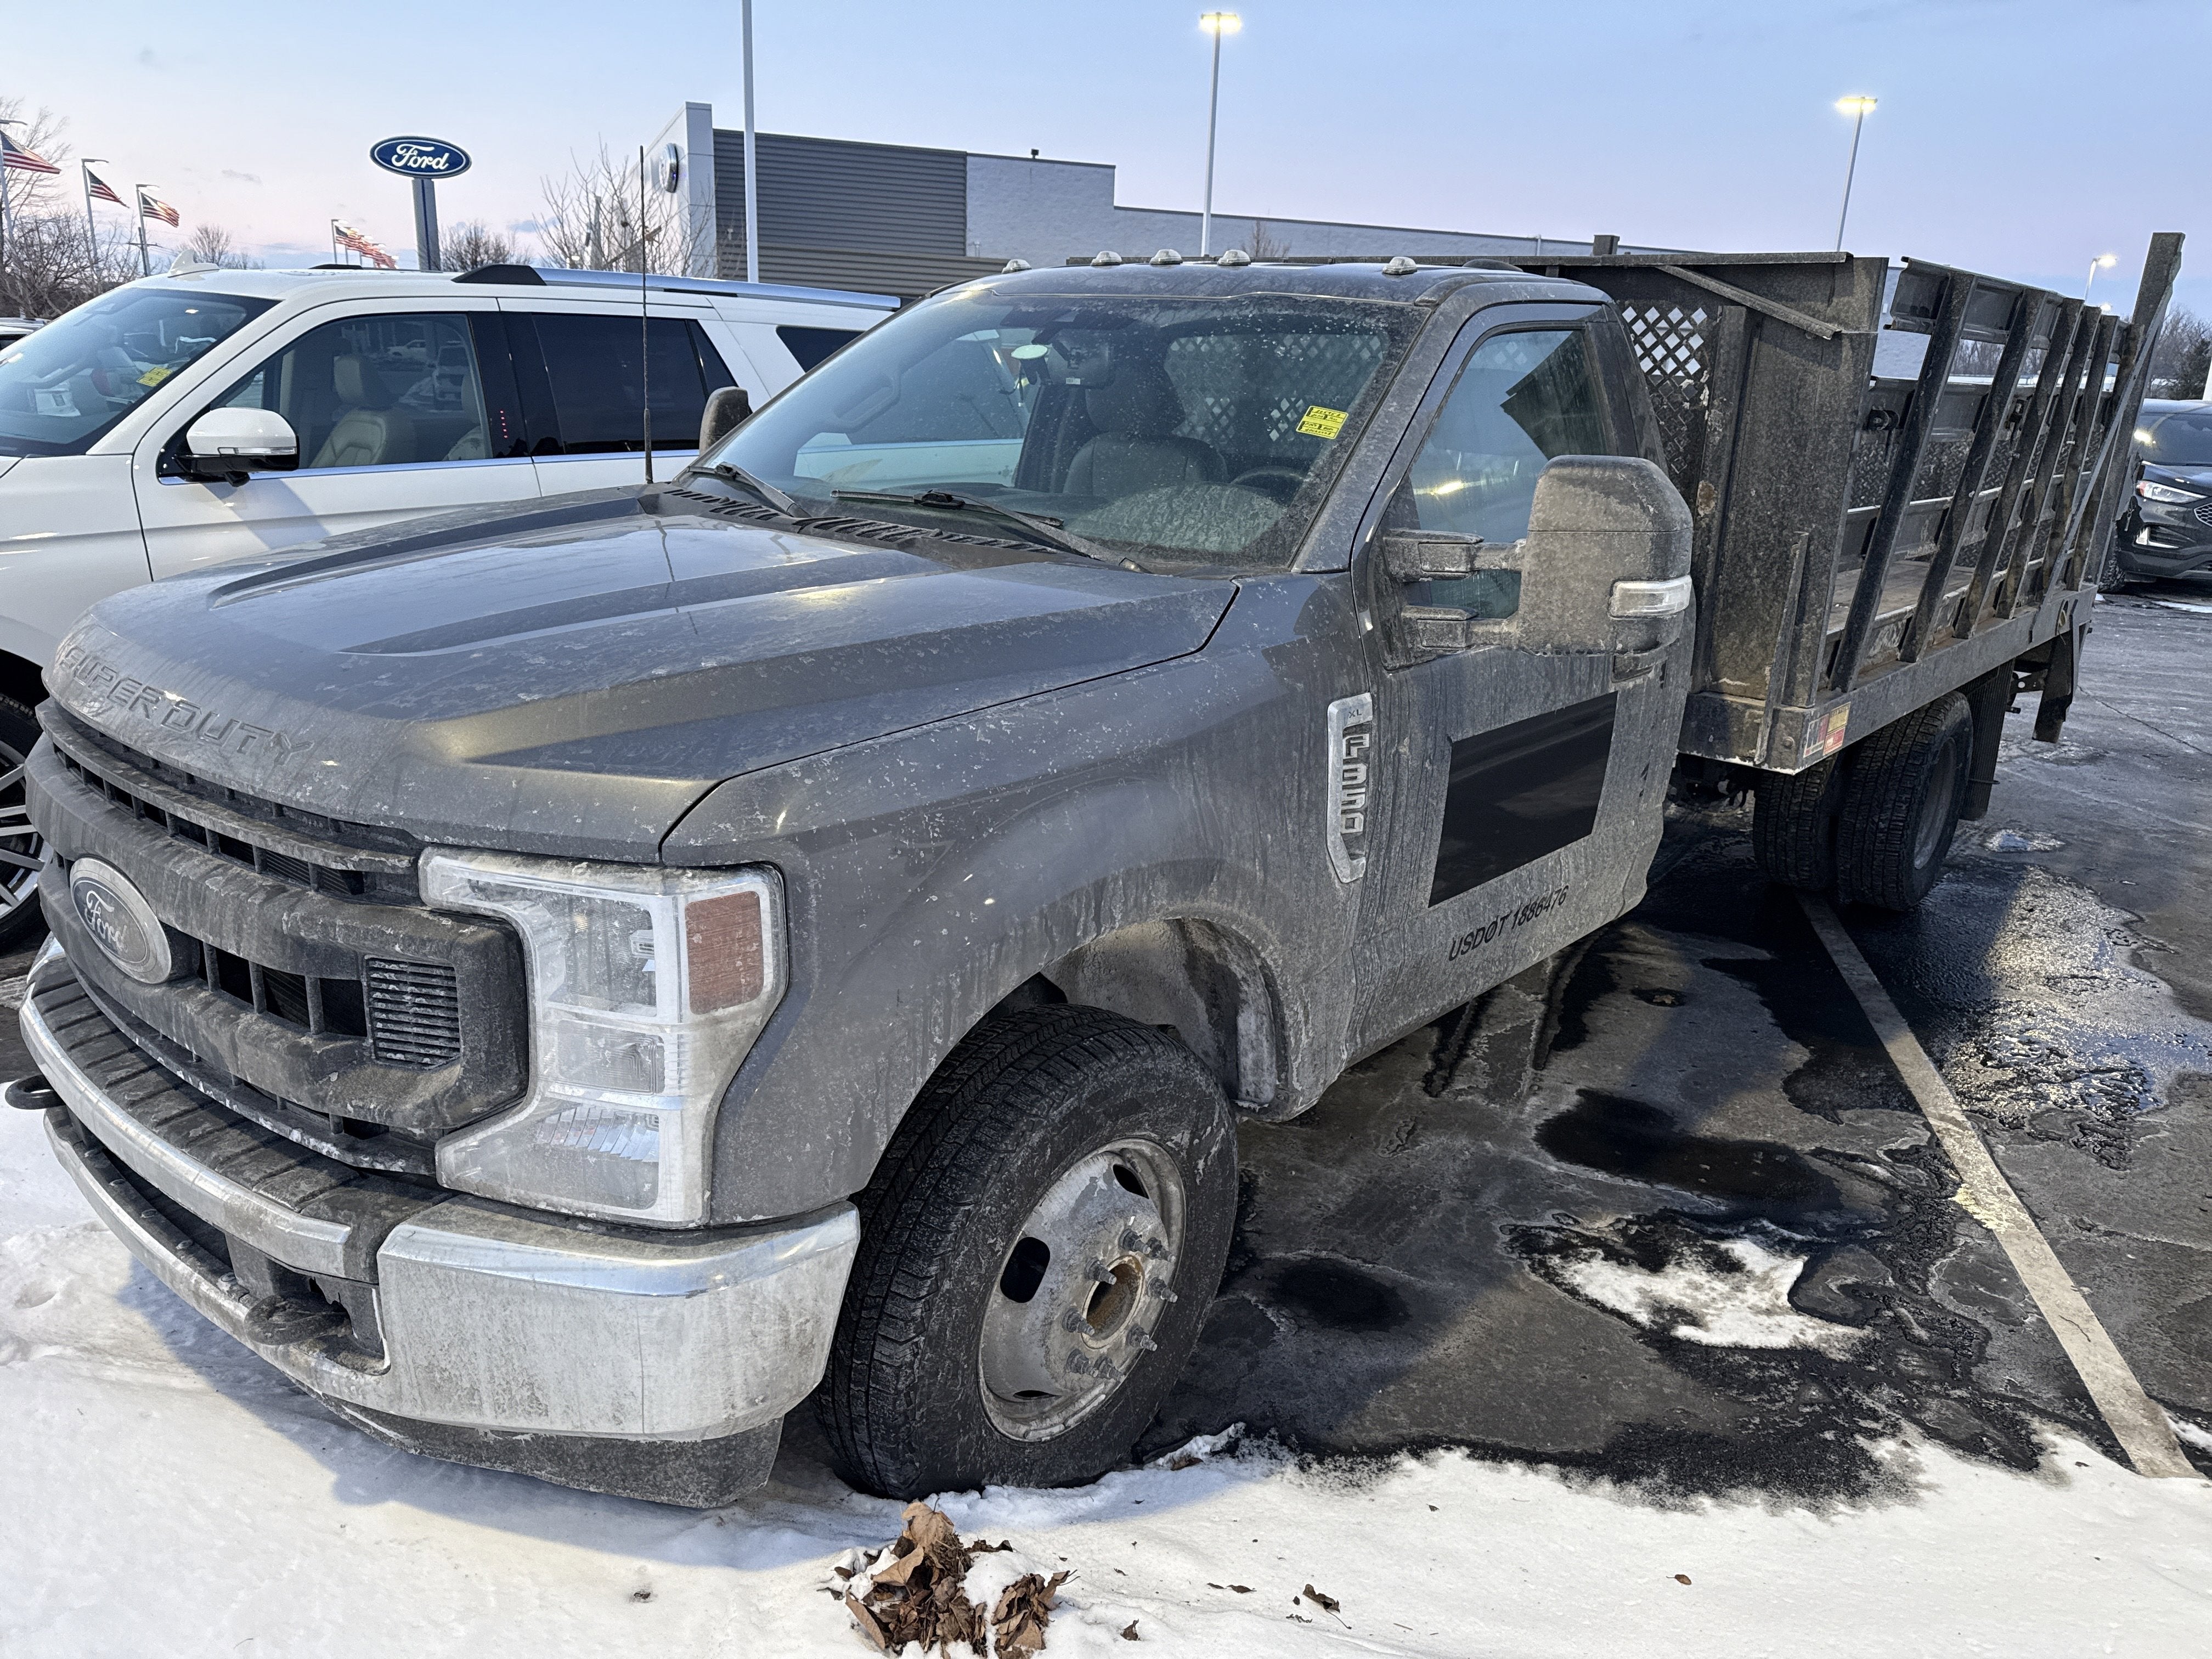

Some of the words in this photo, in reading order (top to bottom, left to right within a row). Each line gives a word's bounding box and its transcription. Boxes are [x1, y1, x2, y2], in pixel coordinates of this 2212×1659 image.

[391, 143, 449, 170] Ford
[59, 646, 165, 720] SUPER
[161, 699, 315, 766] DUTY
[1348, 709, 1362, 718] XL
[1341, 732, 1370, 834] F350
[84, 890, 128, 953] Ford
[1448, 910, 1513, 962] USDOT
[1511, 884, 1570, 930] 1886476
